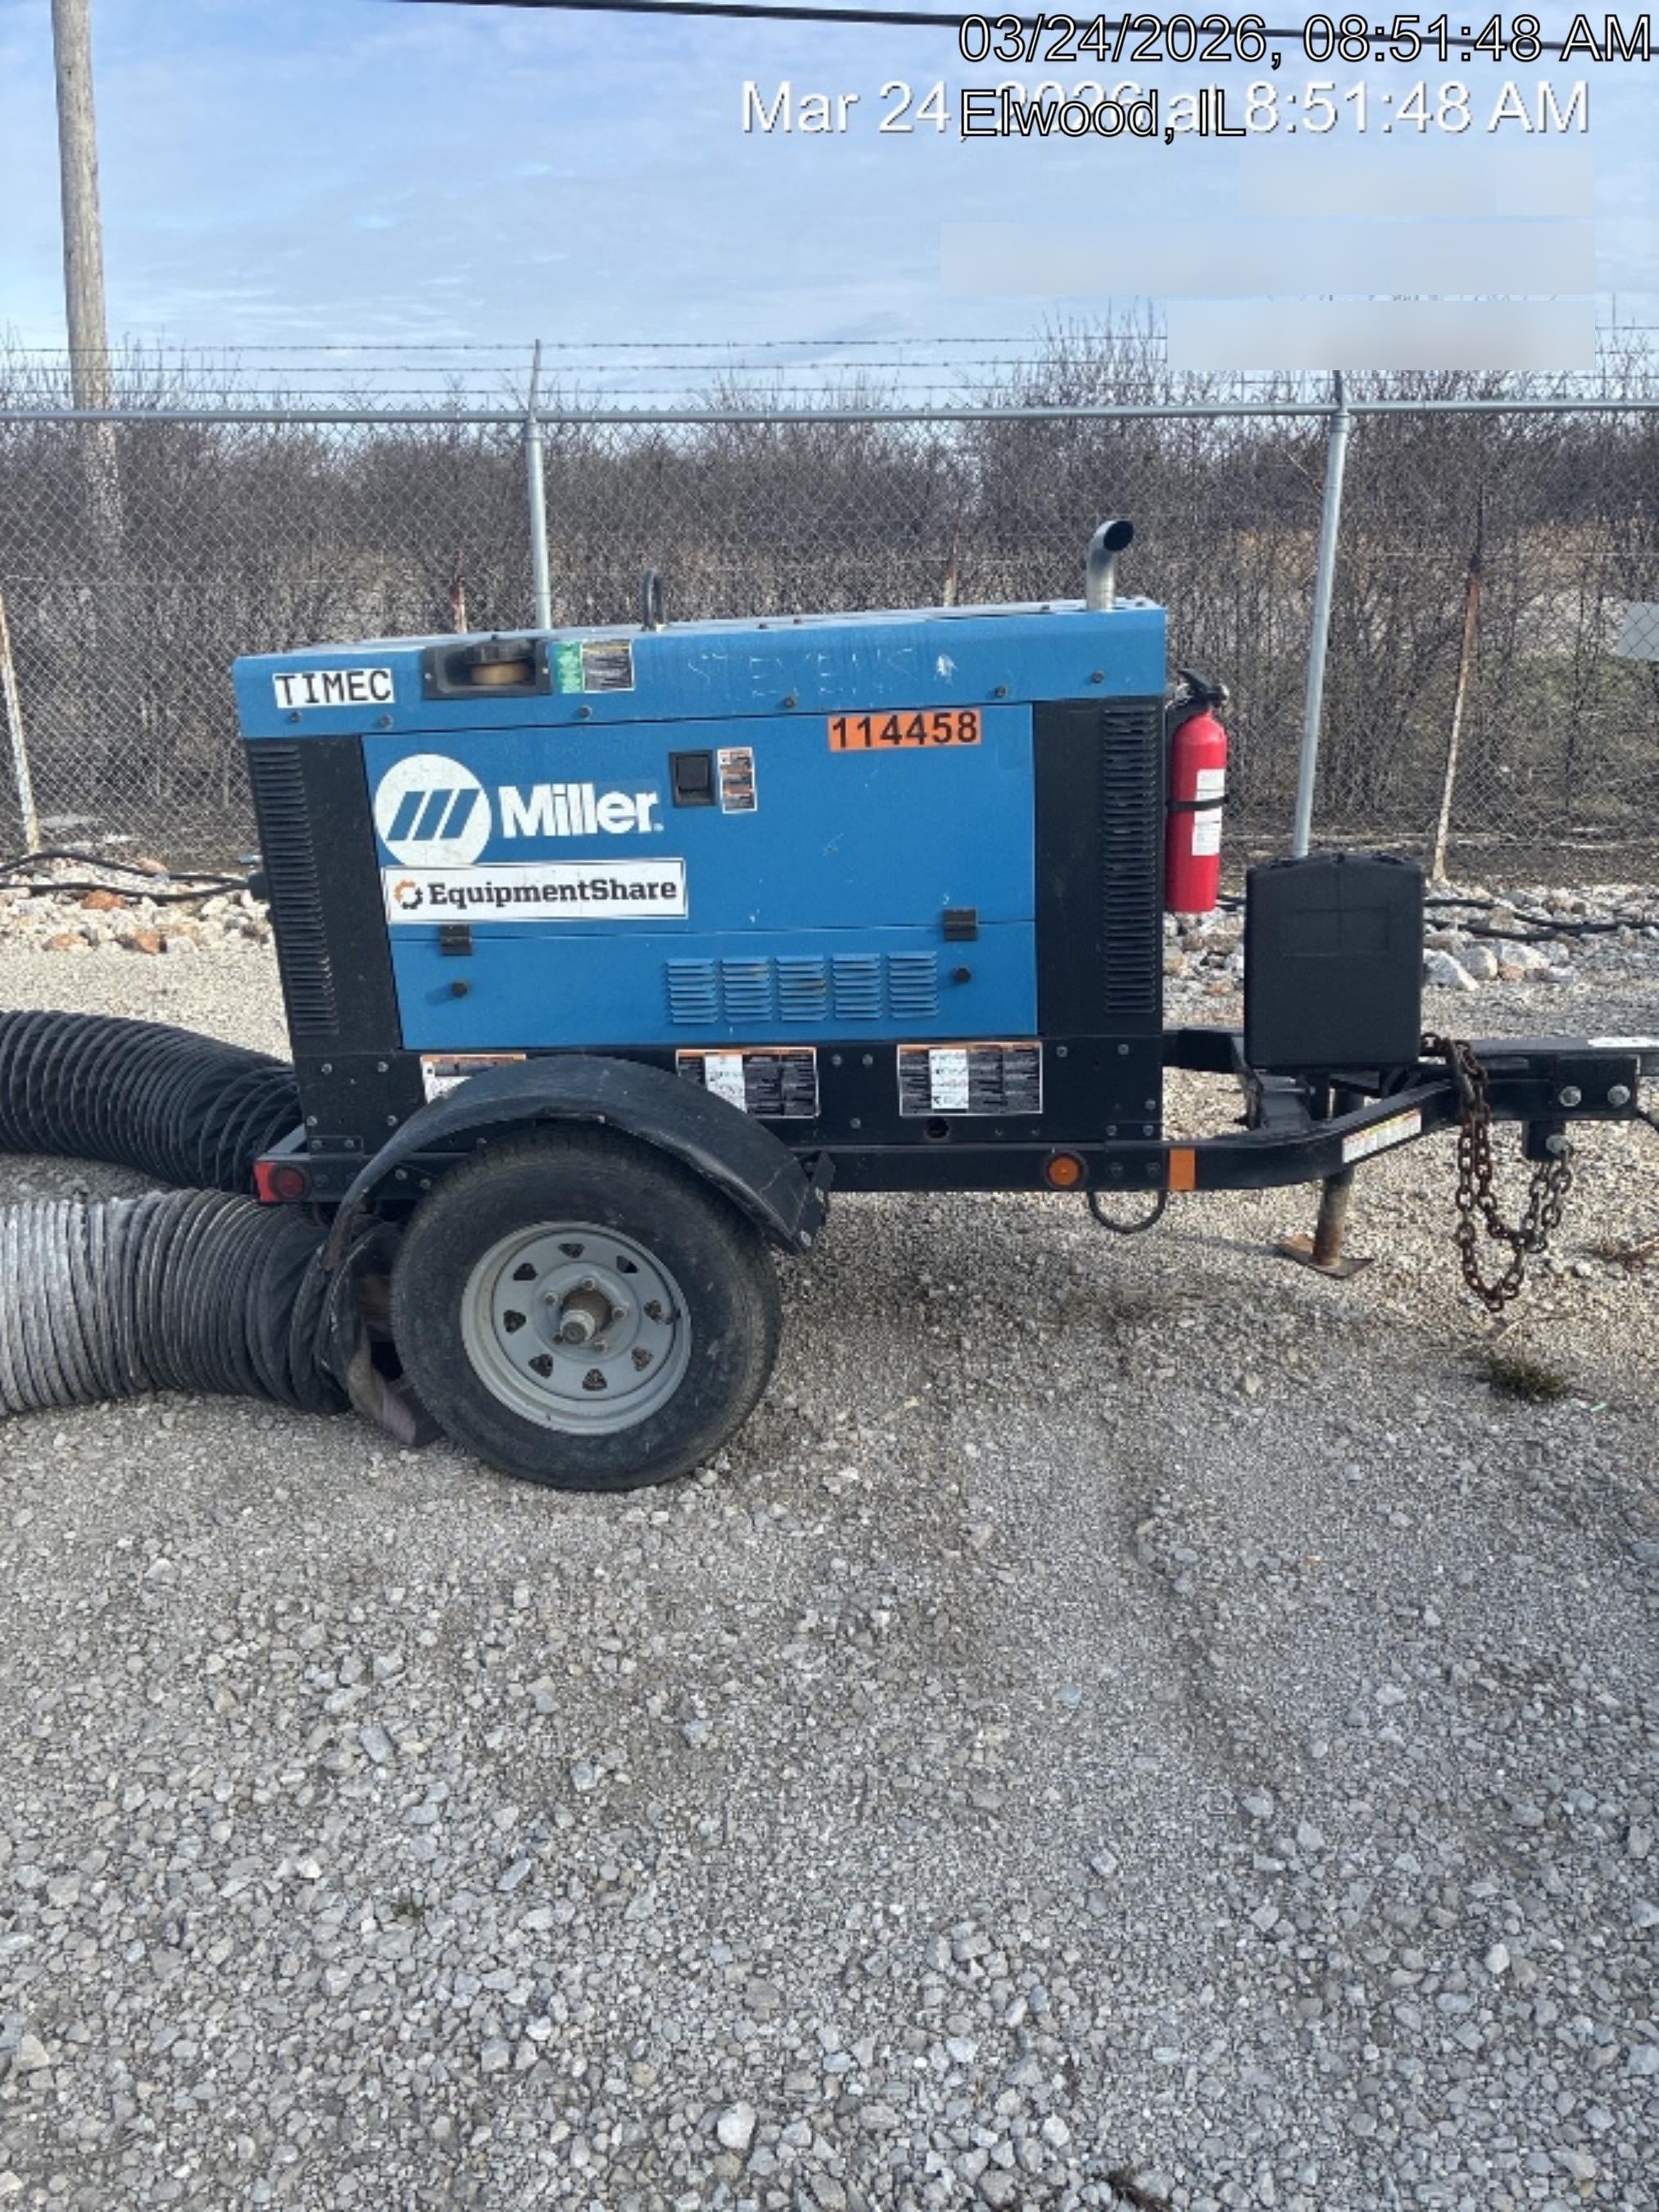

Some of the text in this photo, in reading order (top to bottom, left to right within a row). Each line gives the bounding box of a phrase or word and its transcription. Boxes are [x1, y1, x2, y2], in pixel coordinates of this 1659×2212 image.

[275, 670, 392, 705] TIMEC
[832, 711, 978, 748] 114458
[429, 878, 678, 908] EquipmentShare
